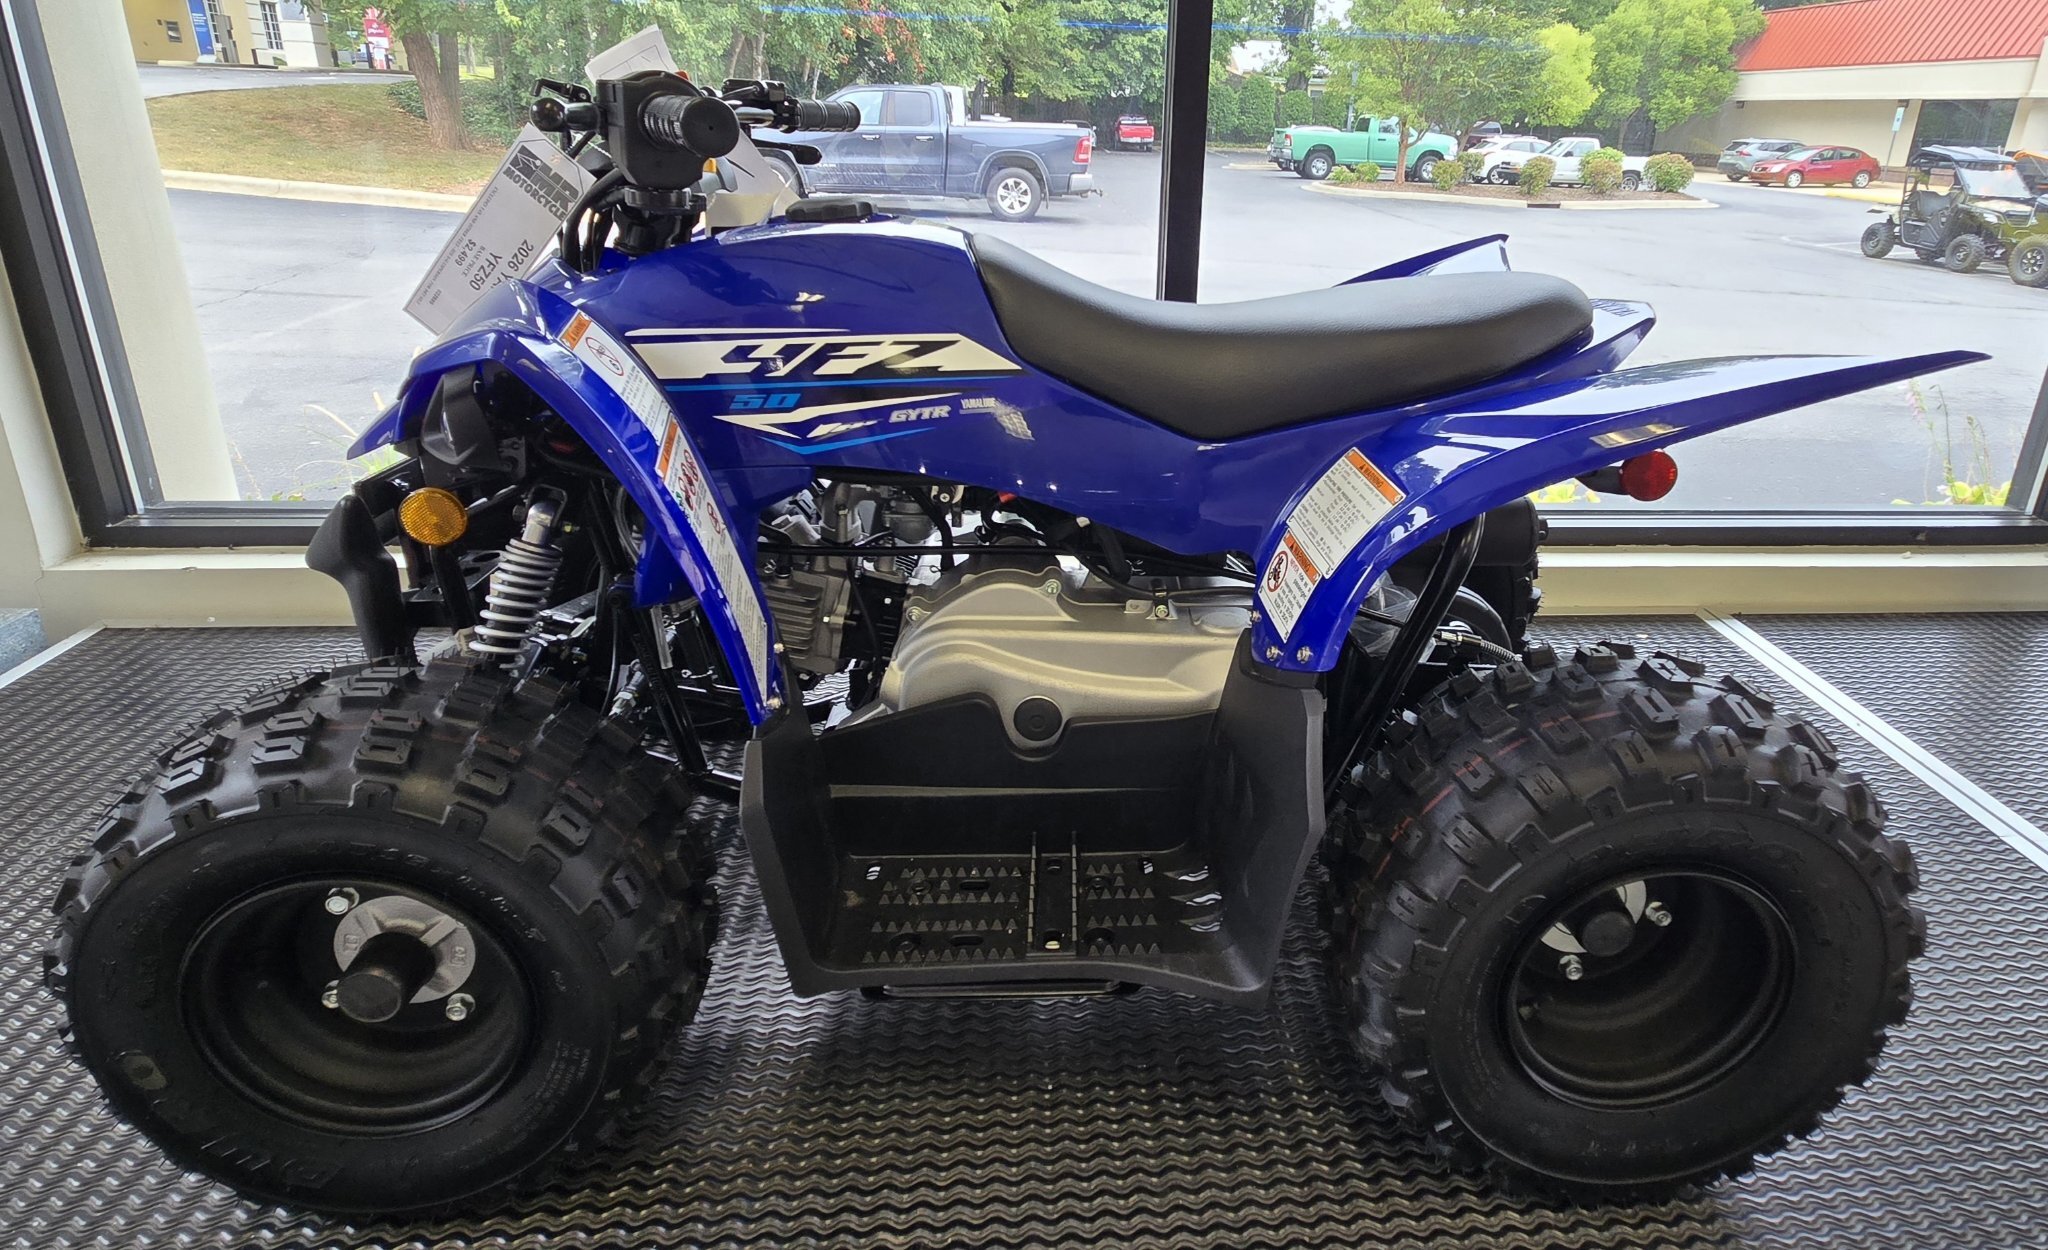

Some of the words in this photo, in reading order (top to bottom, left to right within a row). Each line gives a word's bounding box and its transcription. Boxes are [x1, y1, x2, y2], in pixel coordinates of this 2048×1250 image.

[503, 167, 566, 221] MOTORCYCLE
[531, 163, 579, 212] MR
[453, 238, 477, 267] $2,499
[472, 245, 486, 261] BASE
[507, 240, 534, 271] 2026
[460, 259, 476, 278] PRICE
[467, 250, 502, 292] YFZ50
[717, 341, 961, 376] YFZ
[729, 393, 801, 409] 50
[889, 405, 951, 423] GYTR
[1362, 466, 1384, 489] WARNING
[1290, 558, 1300, 574] NEVER
[1294, 546, 1311, 572] WARNING
